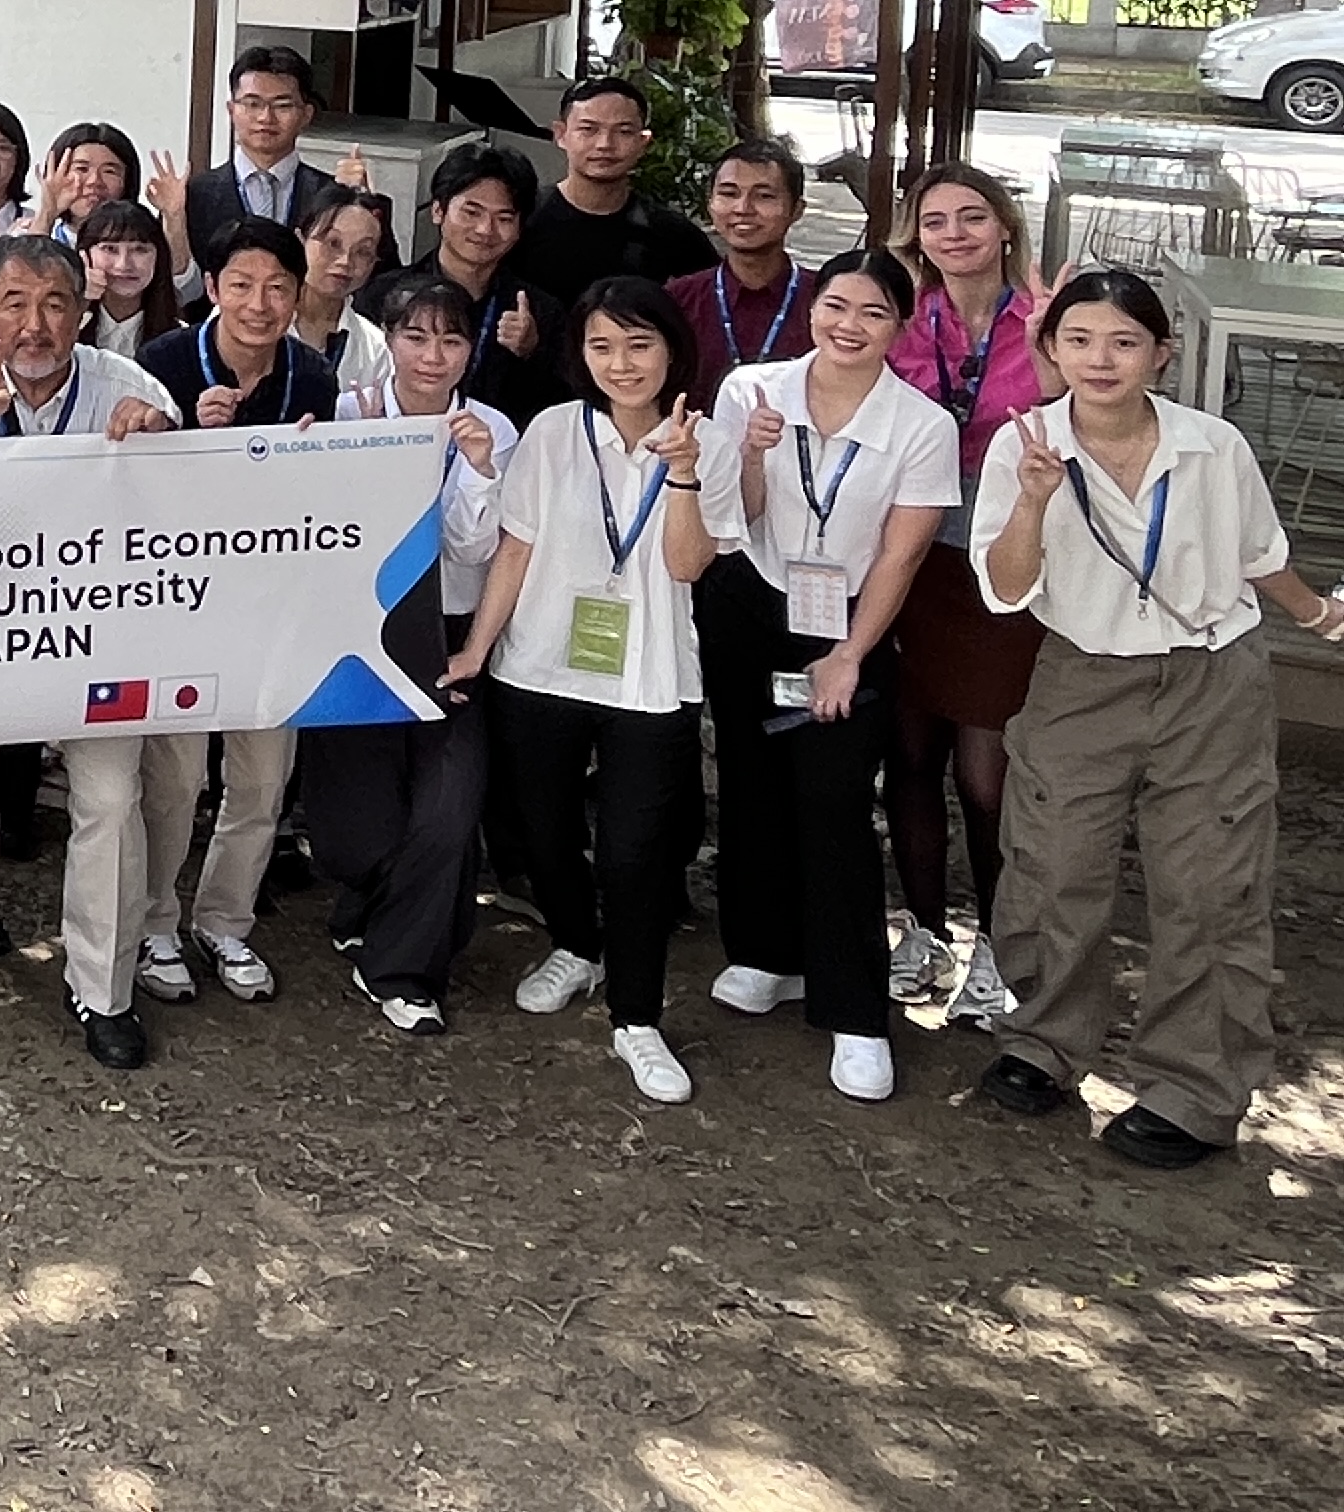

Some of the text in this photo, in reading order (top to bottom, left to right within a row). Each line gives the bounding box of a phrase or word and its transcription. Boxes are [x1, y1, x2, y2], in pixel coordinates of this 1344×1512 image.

[273, 434, 434, 455] GLOBAL COLLABORATION
[57, 528, 104, 567] of
[124, 515, 363, 563] Economics
